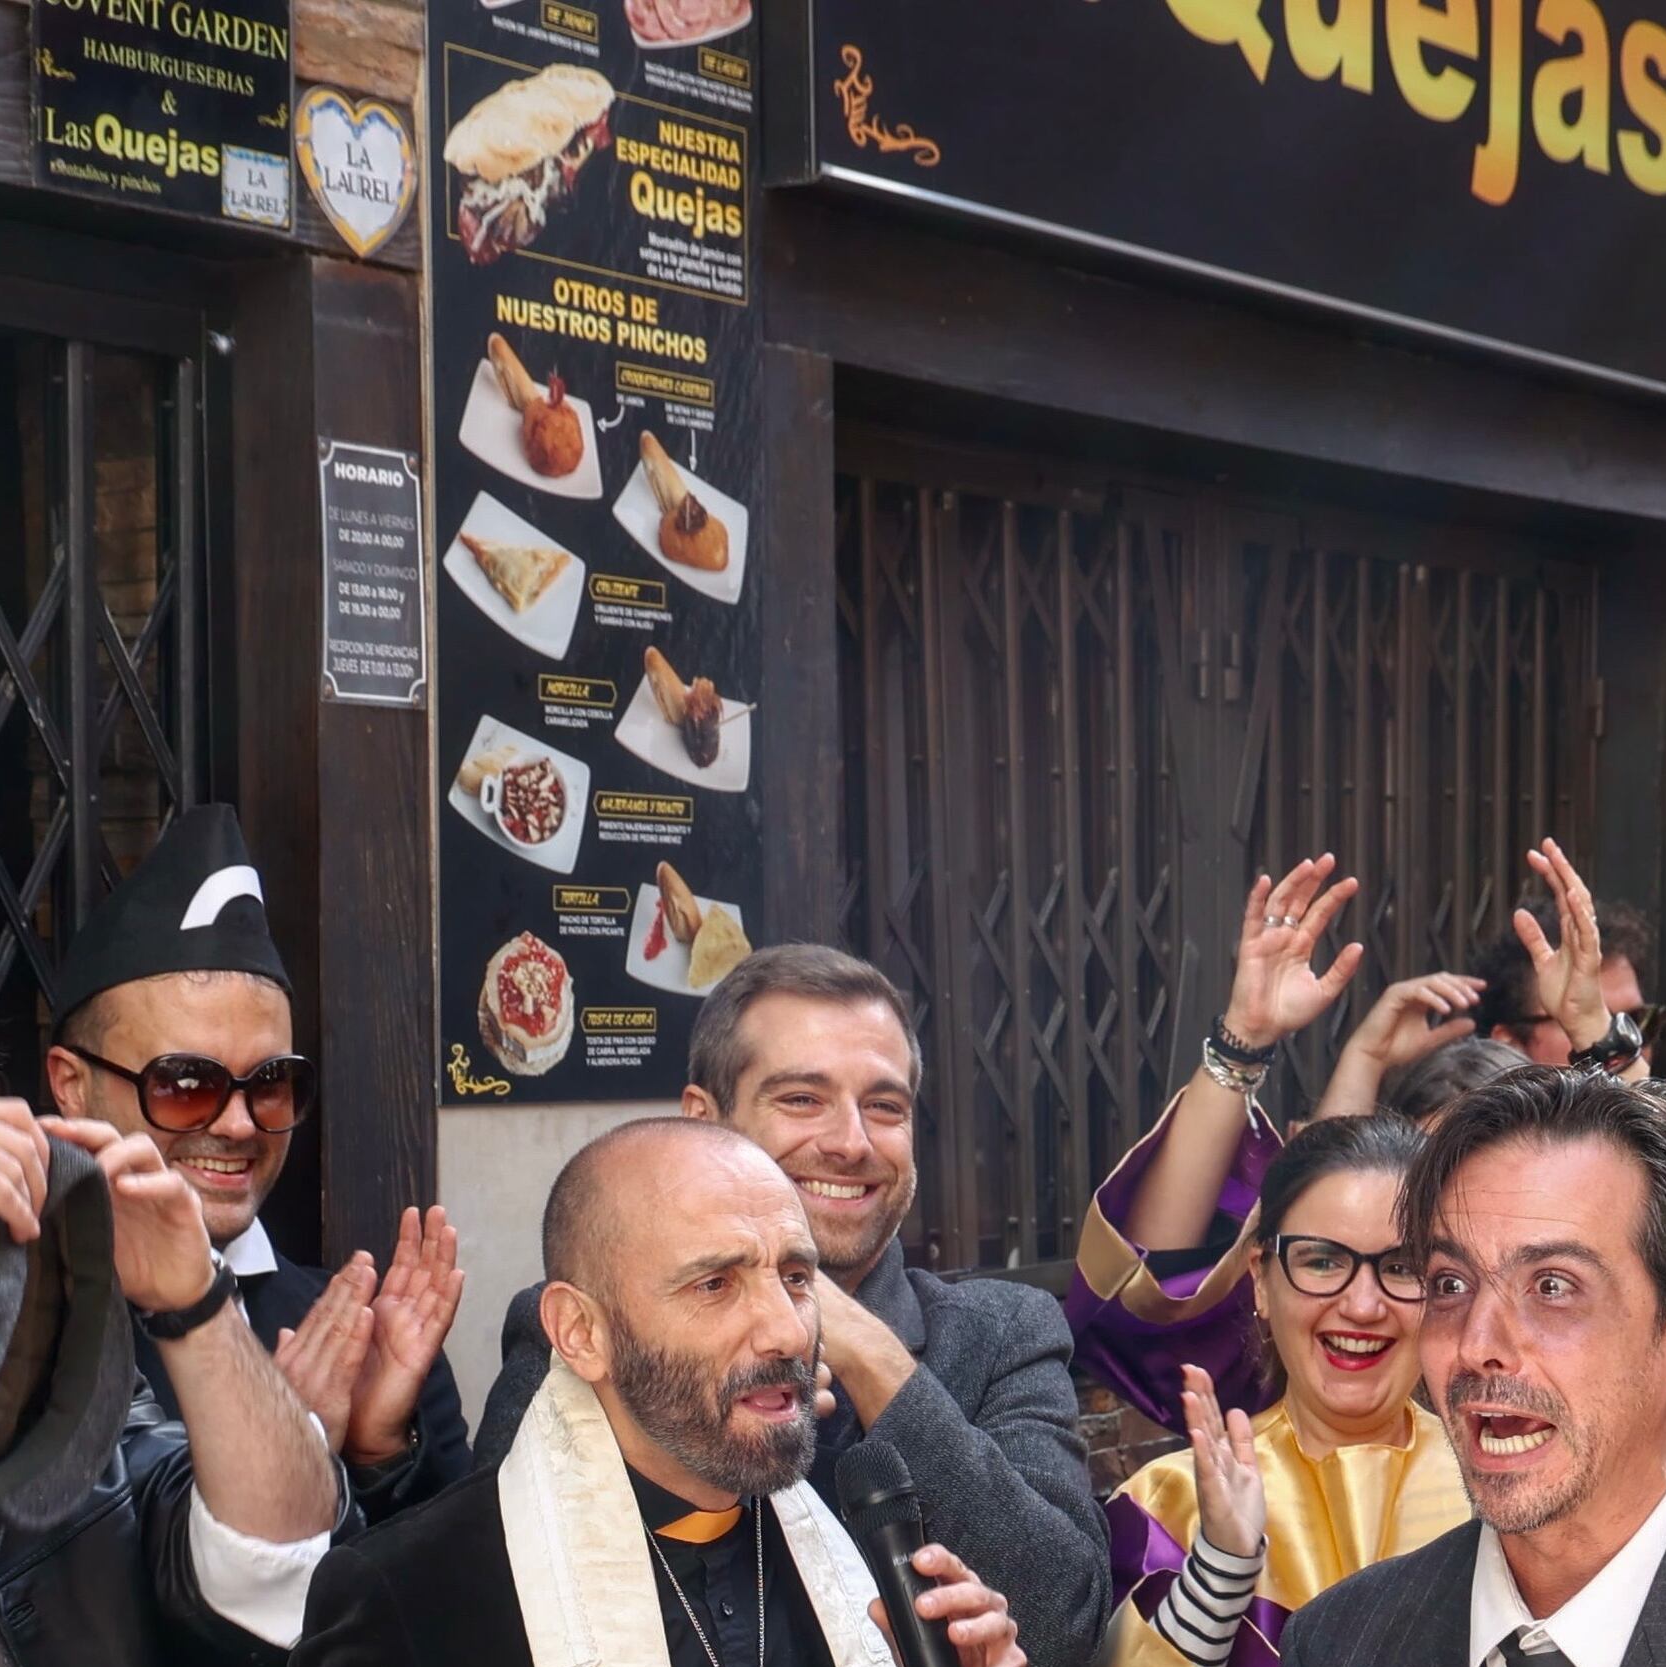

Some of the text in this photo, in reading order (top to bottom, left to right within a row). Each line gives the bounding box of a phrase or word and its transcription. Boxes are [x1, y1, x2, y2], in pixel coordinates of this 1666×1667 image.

[44, 0, 288, 62] ENT GARDEN
[83, 37, 255, 97] HAMBURGUESERIAS
[160, 89, 179, 116] &
[44, 106, 220, 178] Las Quejas
[345, 142, 373, 171] LA
[659, 119, 741, 164] NUESTRA
[247, 169, 269, 190] LA
[616, 136, 741, 191] ESPECIALIDAD
[323, 166, 396, 205] LAUREL
[630, 170, 743, 239] Quejas
[553, 277, 658, 325] OTROS DE
[496, 294, 708, 364] NUESTROS PINCHOS
[334, 461, 405, 488] HORARIO
[338, 528, 350, 542] DE
[340, 508, 369, 525] LUNES
[378, 513, 415, 531] VIERNES
[338, 581, 350, 595] DE
[338, 601, 350, 615] DE
